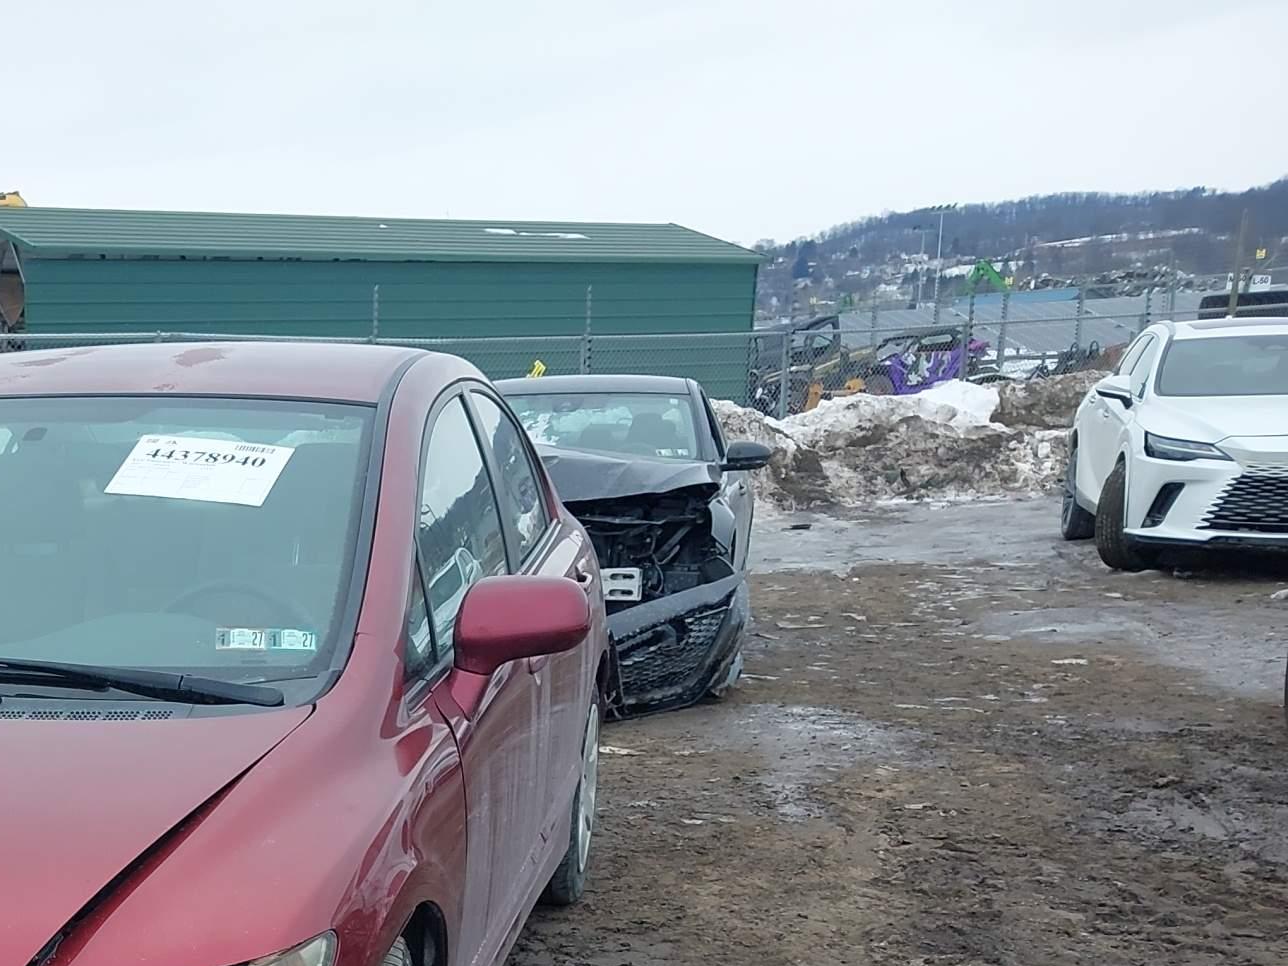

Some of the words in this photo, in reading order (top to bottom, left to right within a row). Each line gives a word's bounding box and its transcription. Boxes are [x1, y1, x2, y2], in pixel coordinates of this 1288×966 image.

[145, 448, 267, 468] 44378940
[252, 631, 263, 648] 27
[302, 632, 313, 648] 27
